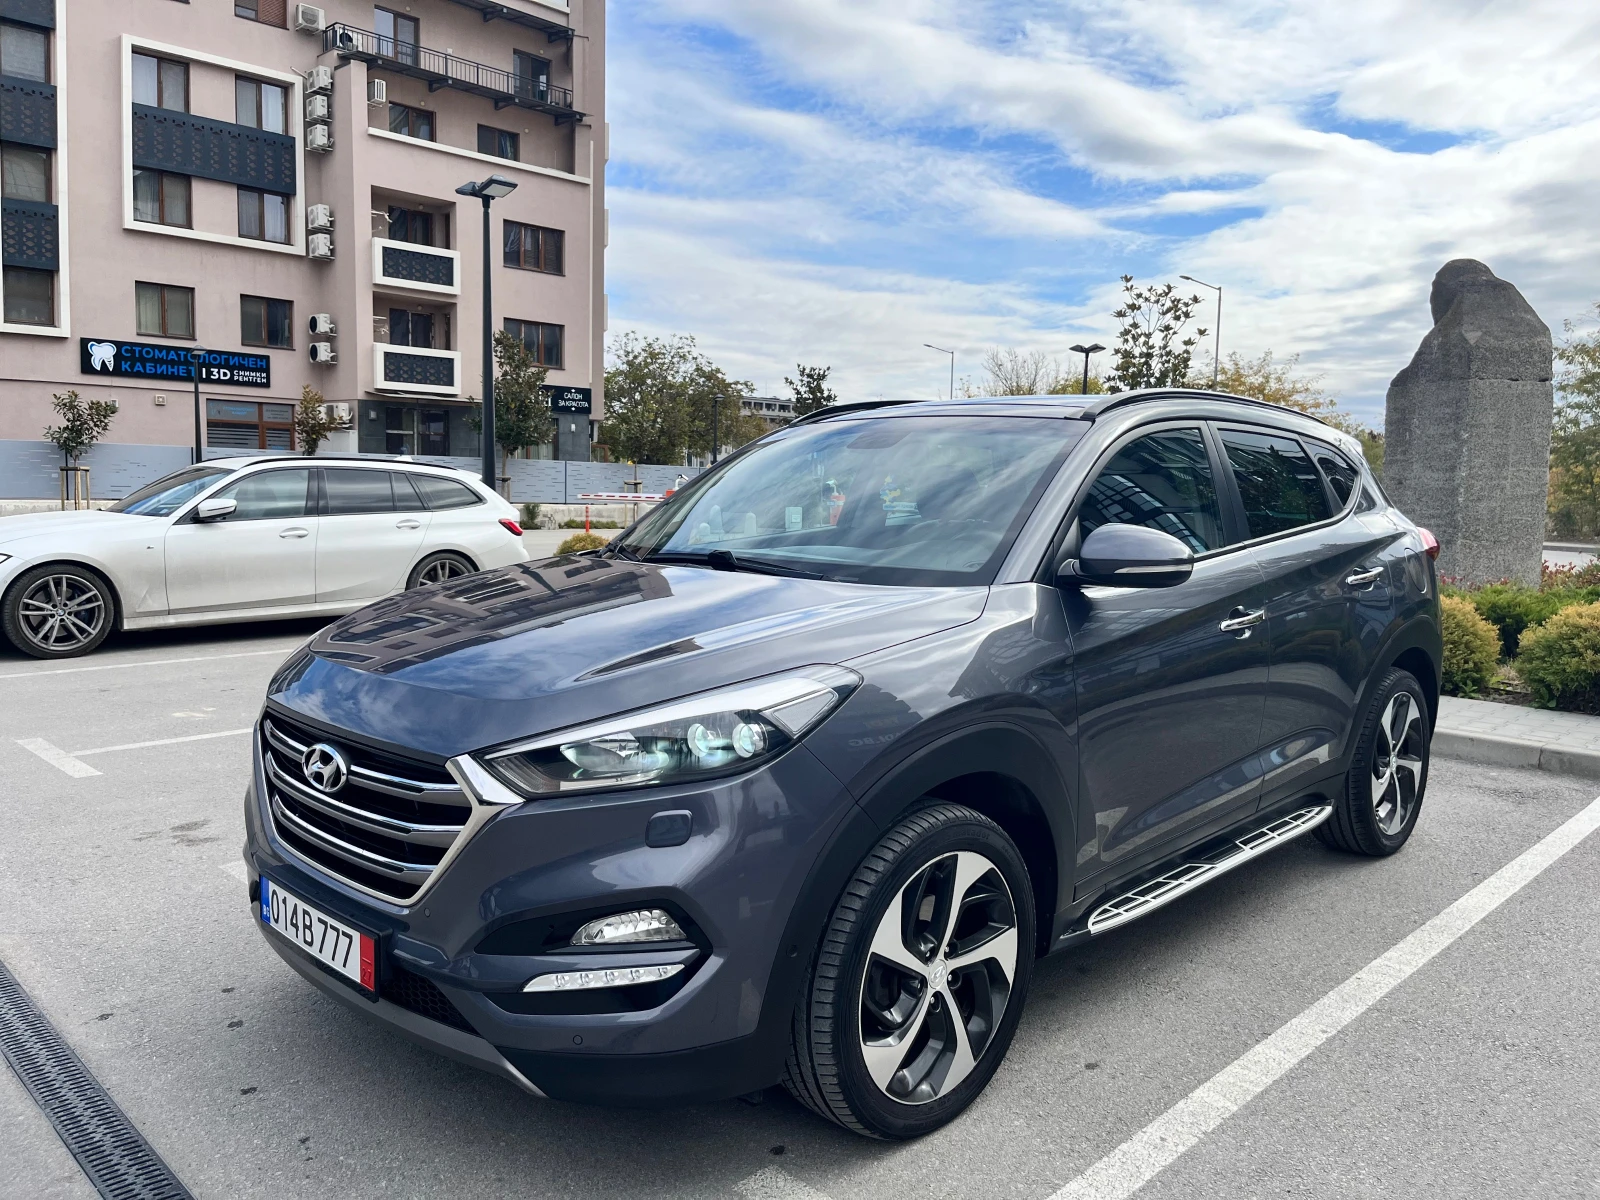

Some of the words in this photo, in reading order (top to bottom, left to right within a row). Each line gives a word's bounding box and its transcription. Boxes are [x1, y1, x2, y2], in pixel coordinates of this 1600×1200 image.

[121, 361, 196, 377] КАБИНЕТ
[210, 368, 231, 380] 3D
[233, 369, 267, 378] СНИМКИ
[233, 375, 267, 384] РЕНТГЕН
[563, 392, 583, 400] САЛОН
[558, 399, 566, 407] ЗА
[566, 400, 589, 408] КРАСОТА
[271, 889, 354, 969] 014B777
